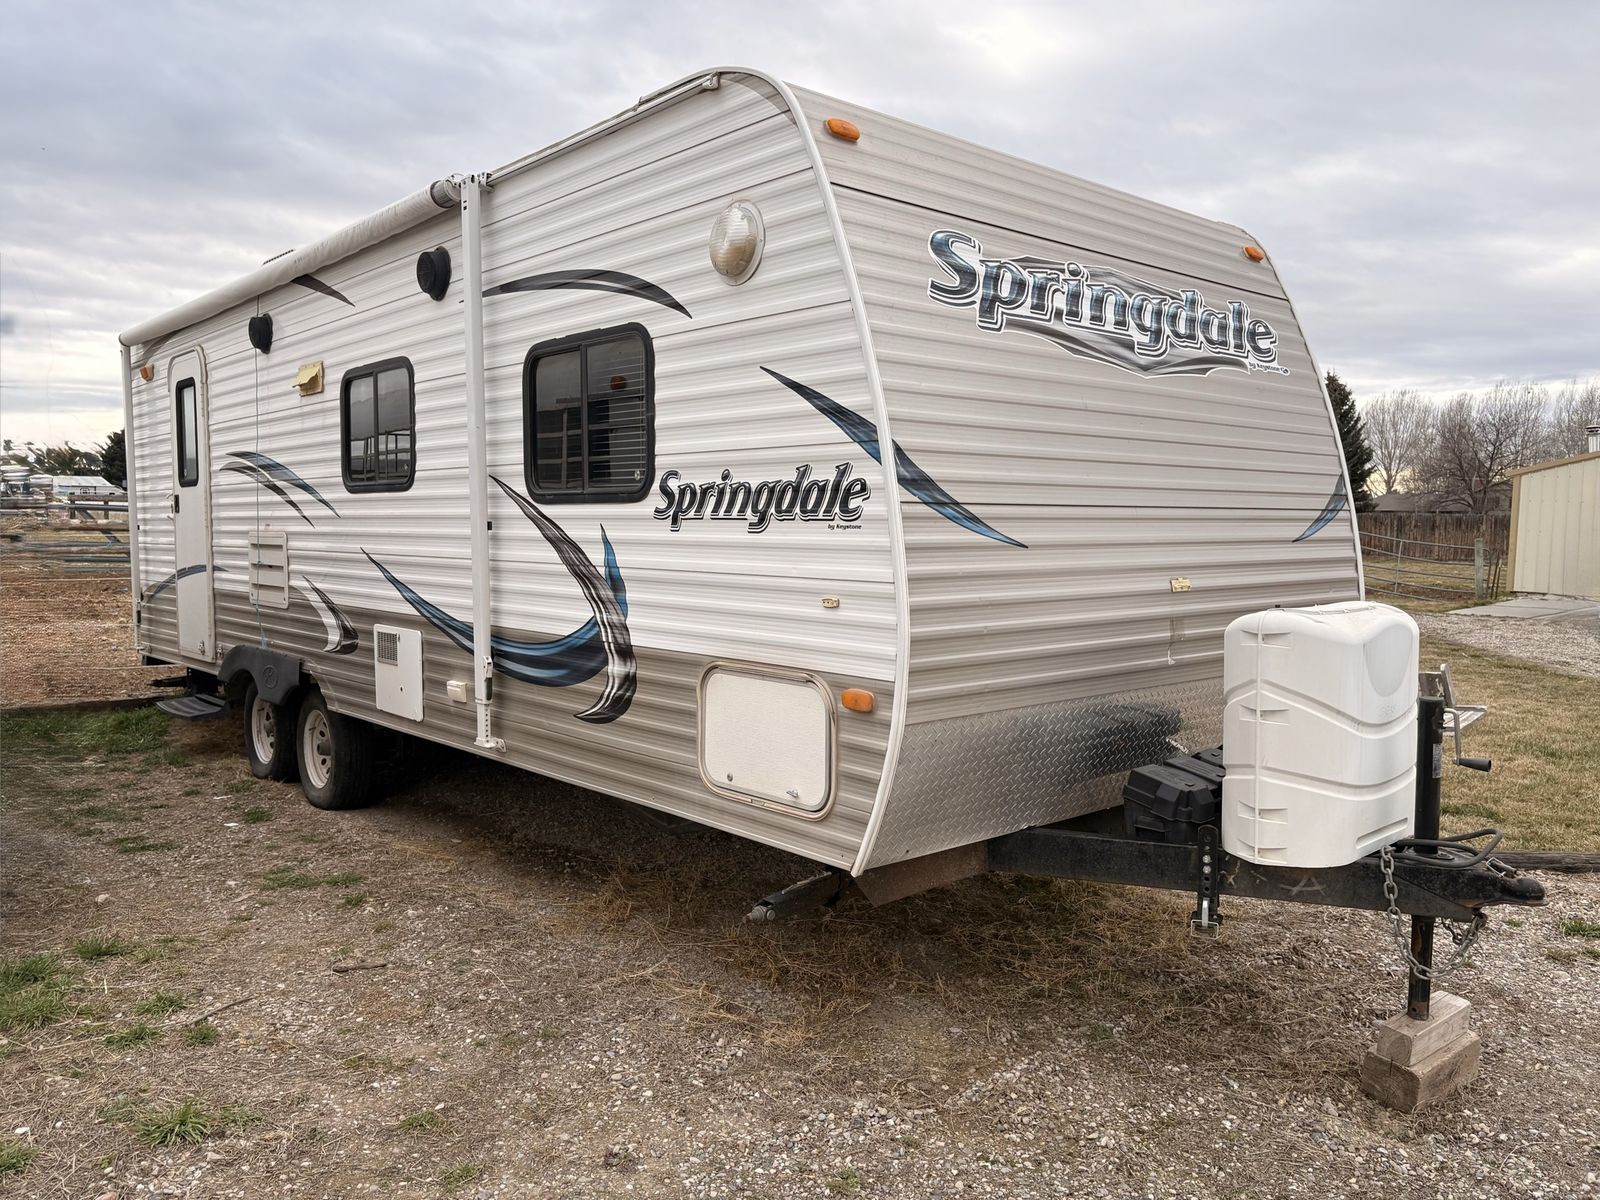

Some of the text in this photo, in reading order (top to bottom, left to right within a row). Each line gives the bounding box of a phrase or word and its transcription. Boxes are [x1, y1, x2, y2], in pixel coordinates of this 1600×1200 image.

[928, 229, 1278, 364] Springdale
[653, 462, 872, 533] Springdale
[827, 523, 836, 531] by
